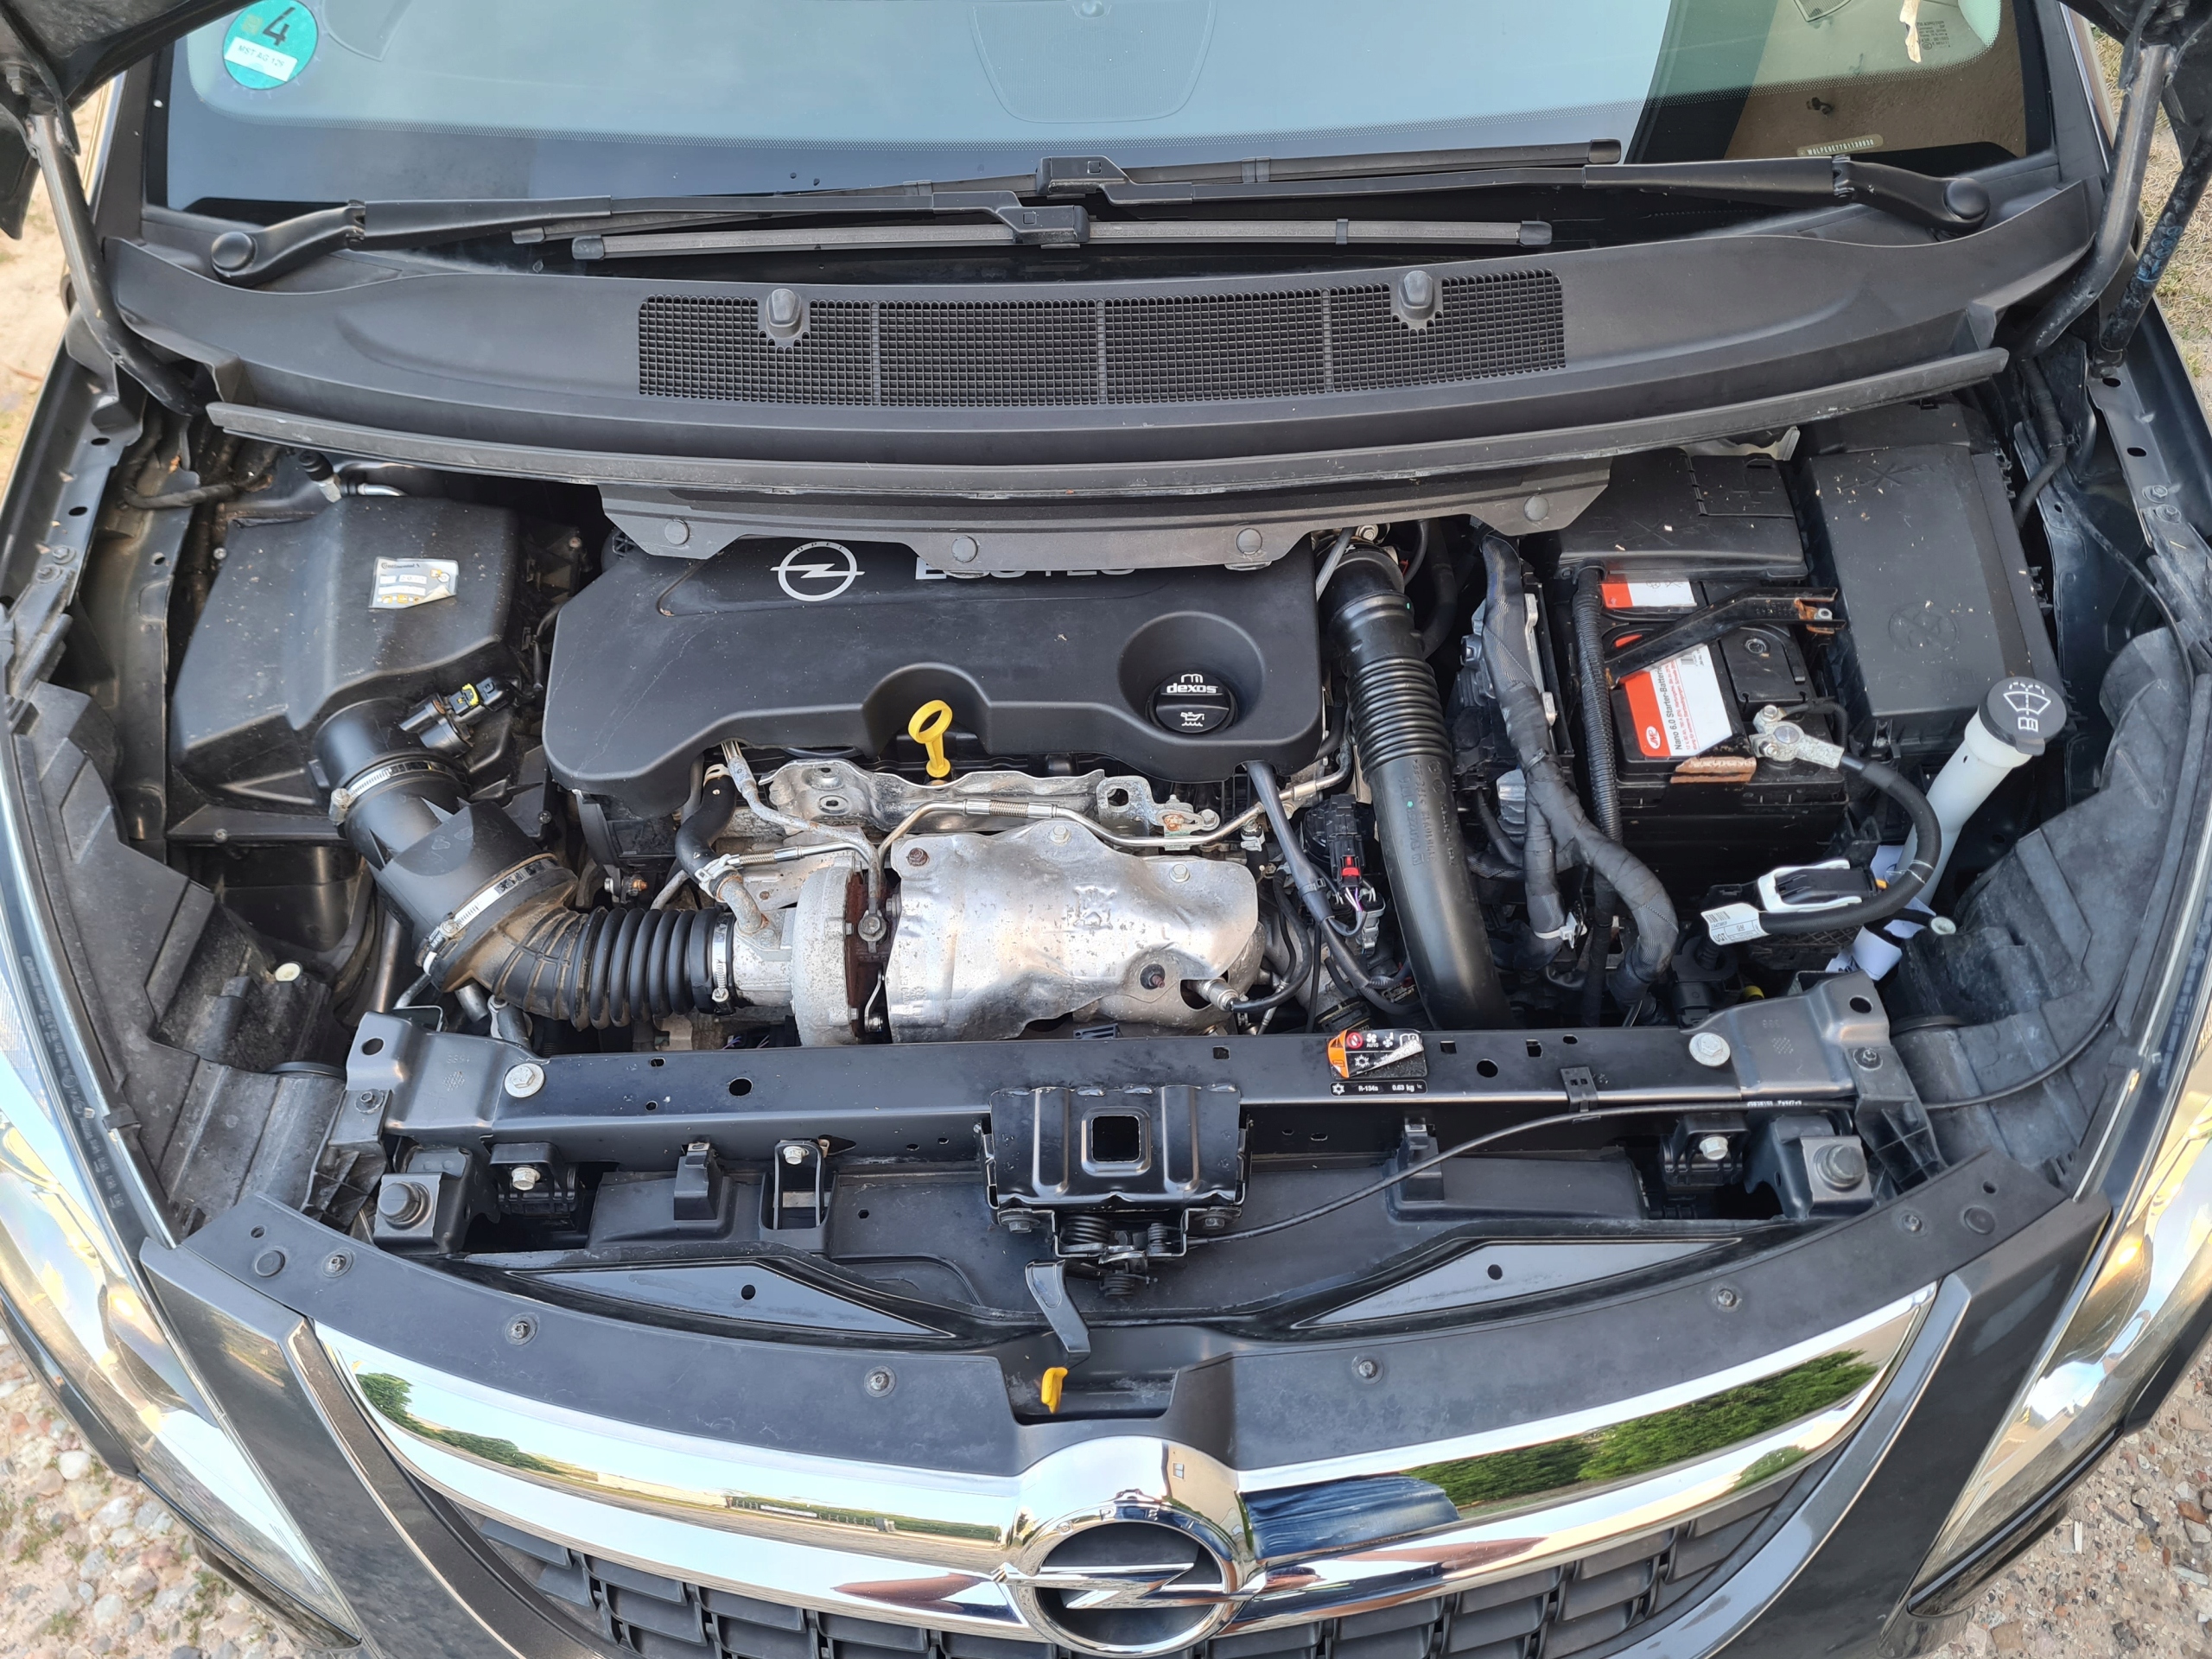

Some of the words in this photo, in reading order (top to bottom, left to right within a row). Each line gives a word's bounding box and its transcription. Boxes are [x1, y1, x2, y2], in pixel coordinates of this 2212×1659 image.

[263, 7, 296, 47] 4
[1166, 683, 1218, 694] dexos
[1656, 665, 1674, 719] Starter-Batterie
[1669, 719, 1677, 730] 6.0
[1672, 731, 1682, 750] Nano
